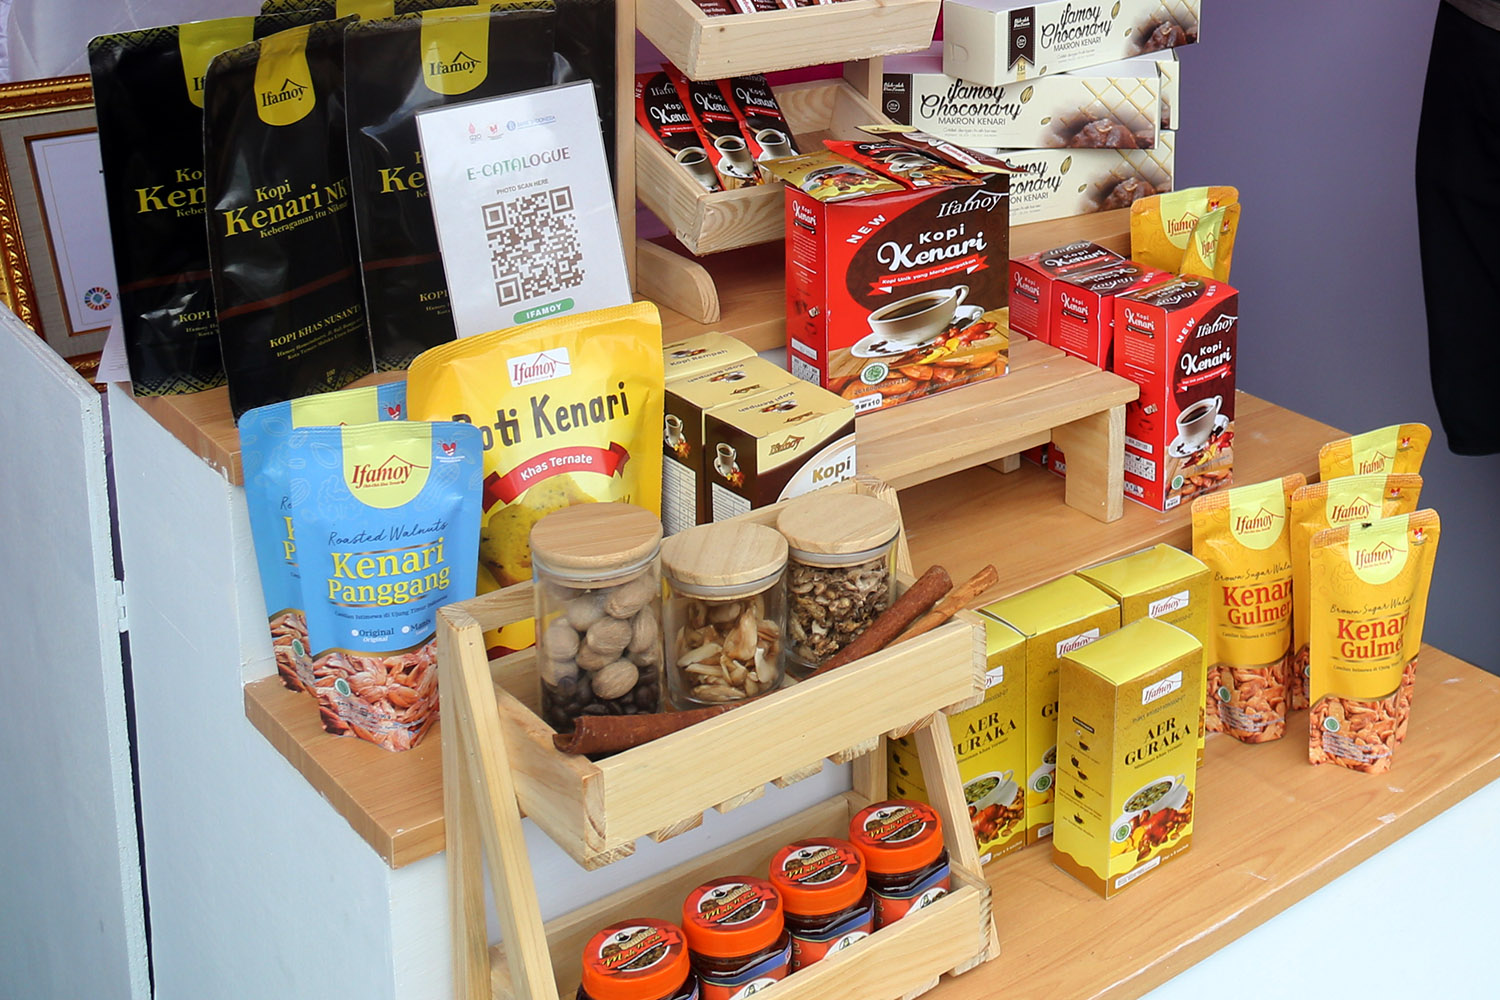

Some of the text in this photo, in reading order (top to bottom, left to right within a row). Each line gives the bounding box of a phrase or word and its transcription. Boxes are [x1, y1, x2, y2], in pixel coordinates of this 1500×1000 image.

[1041, 20, 1111, 49] Choconary
[1053, 37, 1101, 52] MAKRON KENARI
[429, 55, 479, 77] Ifamoy
[261, 84, 308, 108] Ifamoy
[735, 87, 778, 110] Kenari
[749, 87, 766, 96] Kopi
[920, 94, 1022, 119] Choconary
[938, 117, 1006, 126] MAKRON KENARI
[466, 147, 571, 181] E-CATALOGUE
[255, 180, 291, 203] Kopi
[496, 178, 549, 195] PHOTO SCAN HERE
[1023, 192, 1049, 203] KENARI
[222, 184, 322, 238] Kenari
[792, 200, 818, 226] Kenari
[800, 205, 812, 214] Kopi
[936, 193, 1002, 219] Ifamoy
[846, 214, 887, 244] NEW
[919, 223, 965, 245] Kopi
[876, 231, 988, 272] Kenari
[1045, 249, 1107, 267] Kenari
[1063, 250, 1088, 259] Kopi
[897, 275, 911, 283] Unik
[911, 272, 929, 283] yang
[929, 257, 977, 277] Menghangatkan
[1024, 277, 1036, 285] Kopi
[1013, 271, 1041, 297] Kenari
[526, 302, 562, 320] IFAMOY
[1061, 292, 1089, 316] Kenari
[1072, 297, 1084, 305] Kopi
[179, 310, 211, 324] KOPI
[269, 303, 361, 348] KOPI KHAS NUSANT
[1124, 308, 1155, 331] Kenari
[1136, 312, 1150, 321] Kopi
[1195, 317, 1234, 339] Ifamoy
[1176, 318, 1195, 344] NEW
[670, 349, 728, 366] Kopi Rempah
[1200, 341, 1222, 356] Kopi
[1180, 346, 1232, 375] Kenari
[511, 360, 557, 385] Ifamoy
[452, 381, 629, 451] oti Kenari
[352, 461, 413, 488] Ifamoy
[520, 453, 593, 481] Khas Ternate
[812, 456, 851, 483] Kopi
[1358, 455, 1386, 475] Ifamoy
[1331, 503, 1371, 522] Ifamoy
[328, 519, 449, 546] Roasted Walnuts
[1235, 514, 1273, 535] Ifamoy
[331, 537, 445, 580] Kenari
[1355, 547, 1394, 570] Ifamoy
[327, 566, 451, 606] Panggang
[1214, 566, 1273, 583] Brown Sugar
[1150, 599, 1180, 617] Ifamoy
[1330, 603, 1389, 615] Brown Sugar
[359, 627, 395, 638] Original
[1144, 681, 1174, 703] Ifamoy
[964, 712, 999, 736] AER
[1144, 717, 1176, 744] AER
[1124, 724, 1191, 766] GURAKA
